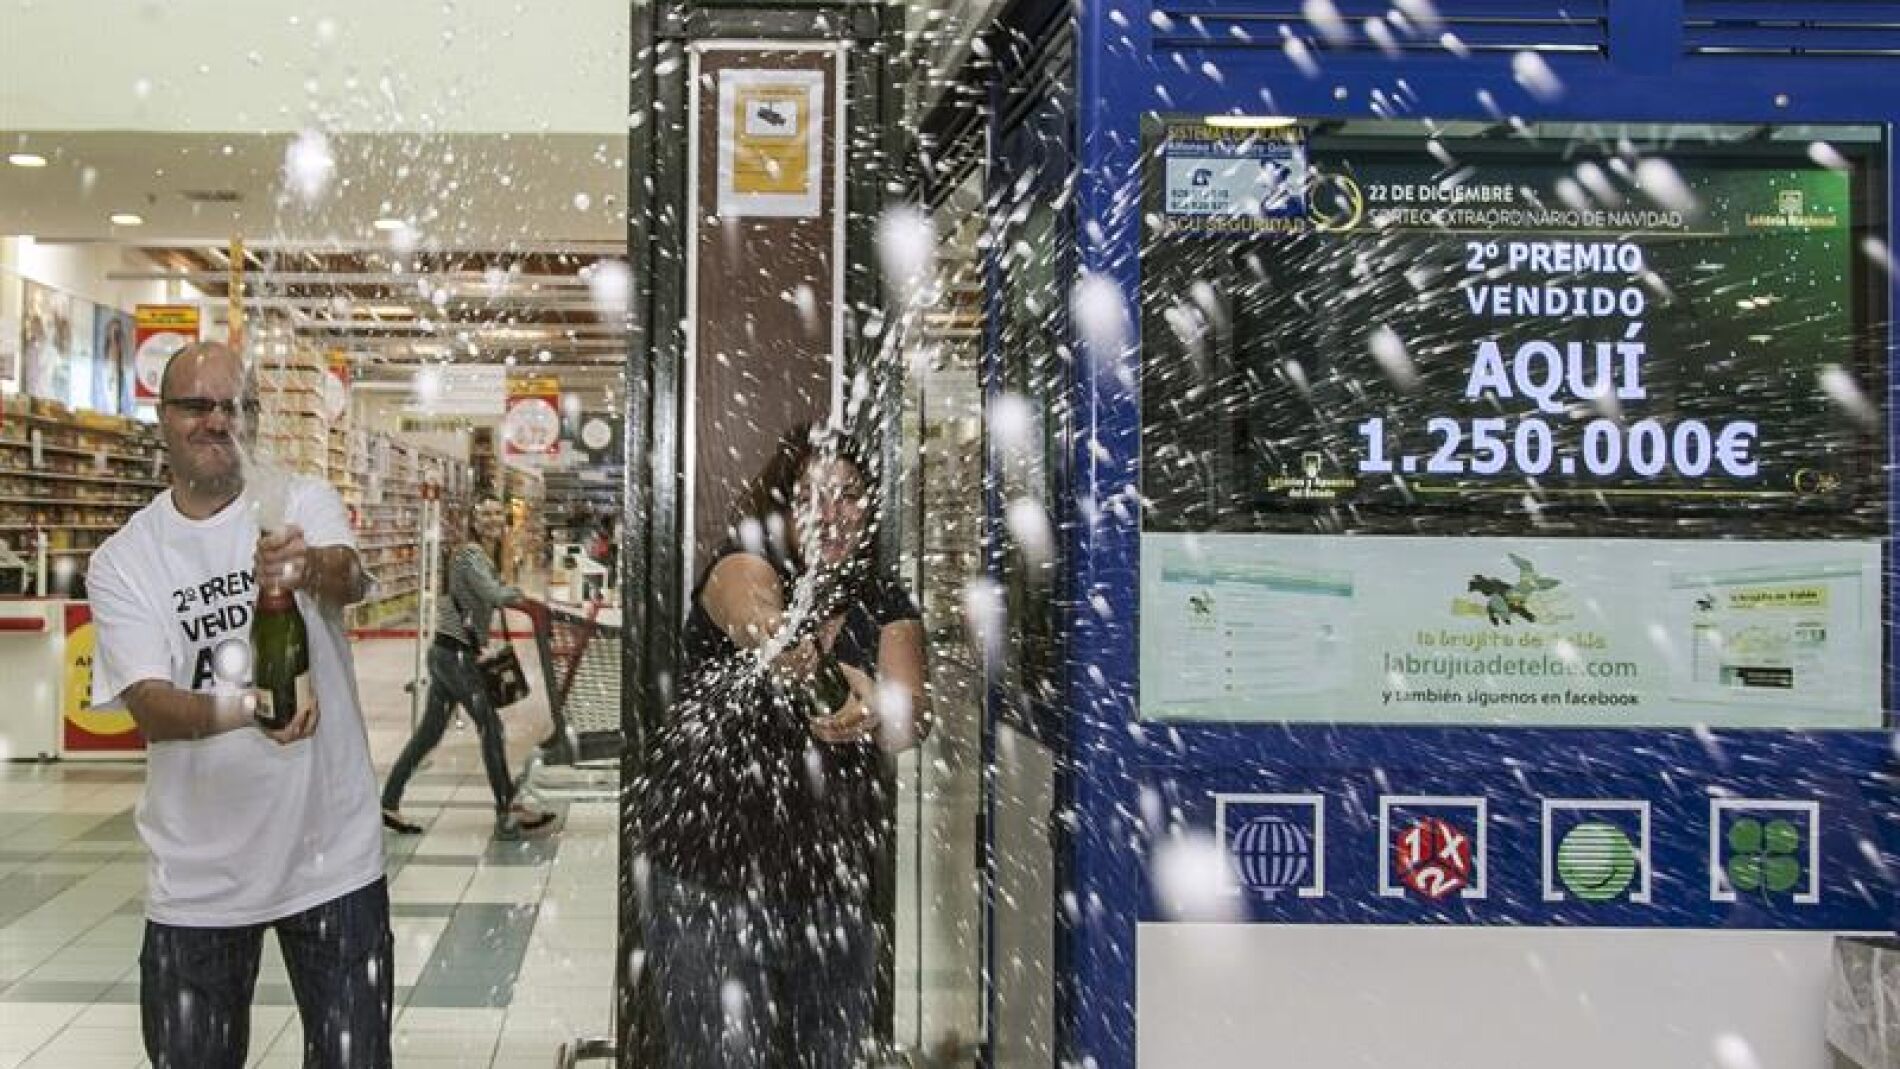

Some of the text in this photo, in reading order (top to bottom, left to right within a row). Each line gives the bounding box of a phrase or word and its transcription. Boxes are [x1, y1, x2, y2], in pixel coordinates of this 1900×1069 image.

[1368, 184, 1514, 203] 22 DE DICIEMBRE
[1437, 208, 1578, 227] EXTRAORDINARIO
[1583, 210, 1605, 227] DE
[1607, 210, 1682, 228] NAVIDAD
[1466, 242, 1643, 273] 2º PREMIO
[1466, 286, 1645, 317] VENDIDO
[1464, 322, 1647, 414] AQUÍ
[1357, 417, 1759, 477] 1.250.000€
[180, 600, 253, 642] VEND
[1441, 630, 1513, 652] brujita
[1381, 690, 1392, 706] y
[1541, 691, 1561, 704] en
[1564, 689, 1639, 706] facebook
